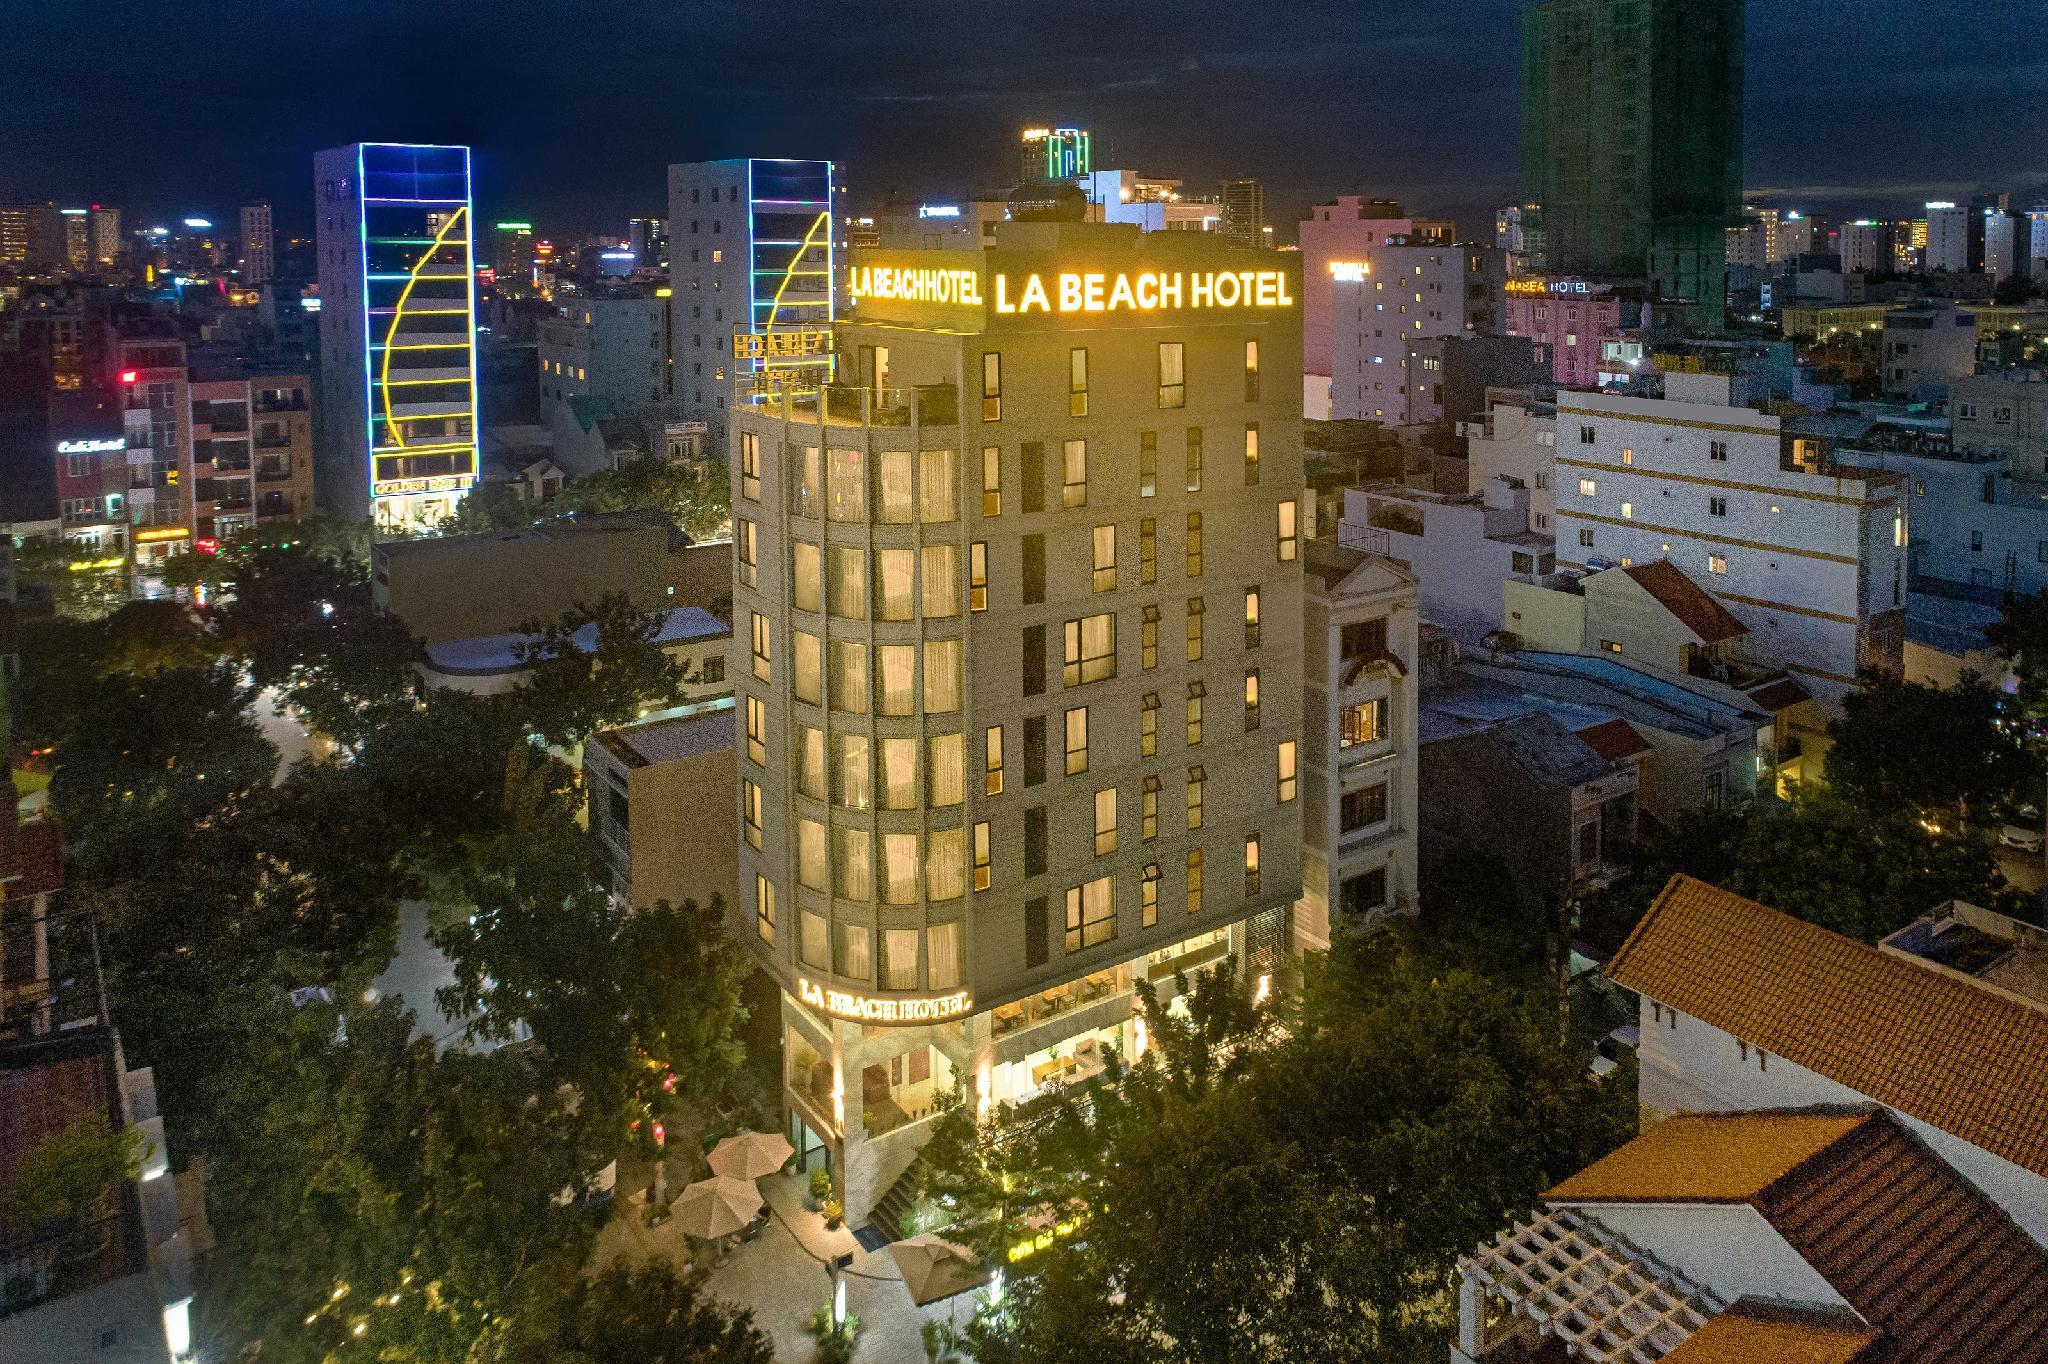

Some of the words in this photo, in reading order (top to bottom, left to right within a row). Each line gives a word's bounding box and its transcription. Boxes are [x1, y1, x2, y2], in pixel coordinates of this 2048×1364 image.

[851, 266, 872, 297] LA
[874, 267, 924, 301] BEACH
[925, 268, 982, 305] HOTEL
[995, 273, 1052, 313] LA
[1058, 271, 1182, 312] BEACH
[1190, 270, 1294, 307] HOTEL
[1550, 281, 1590, 293] HOTEL
[799, 977, 825, 1009] LA
[826, 990, 898, 1021] BEACH
[899, 990, 973, 1021] HOTEL
